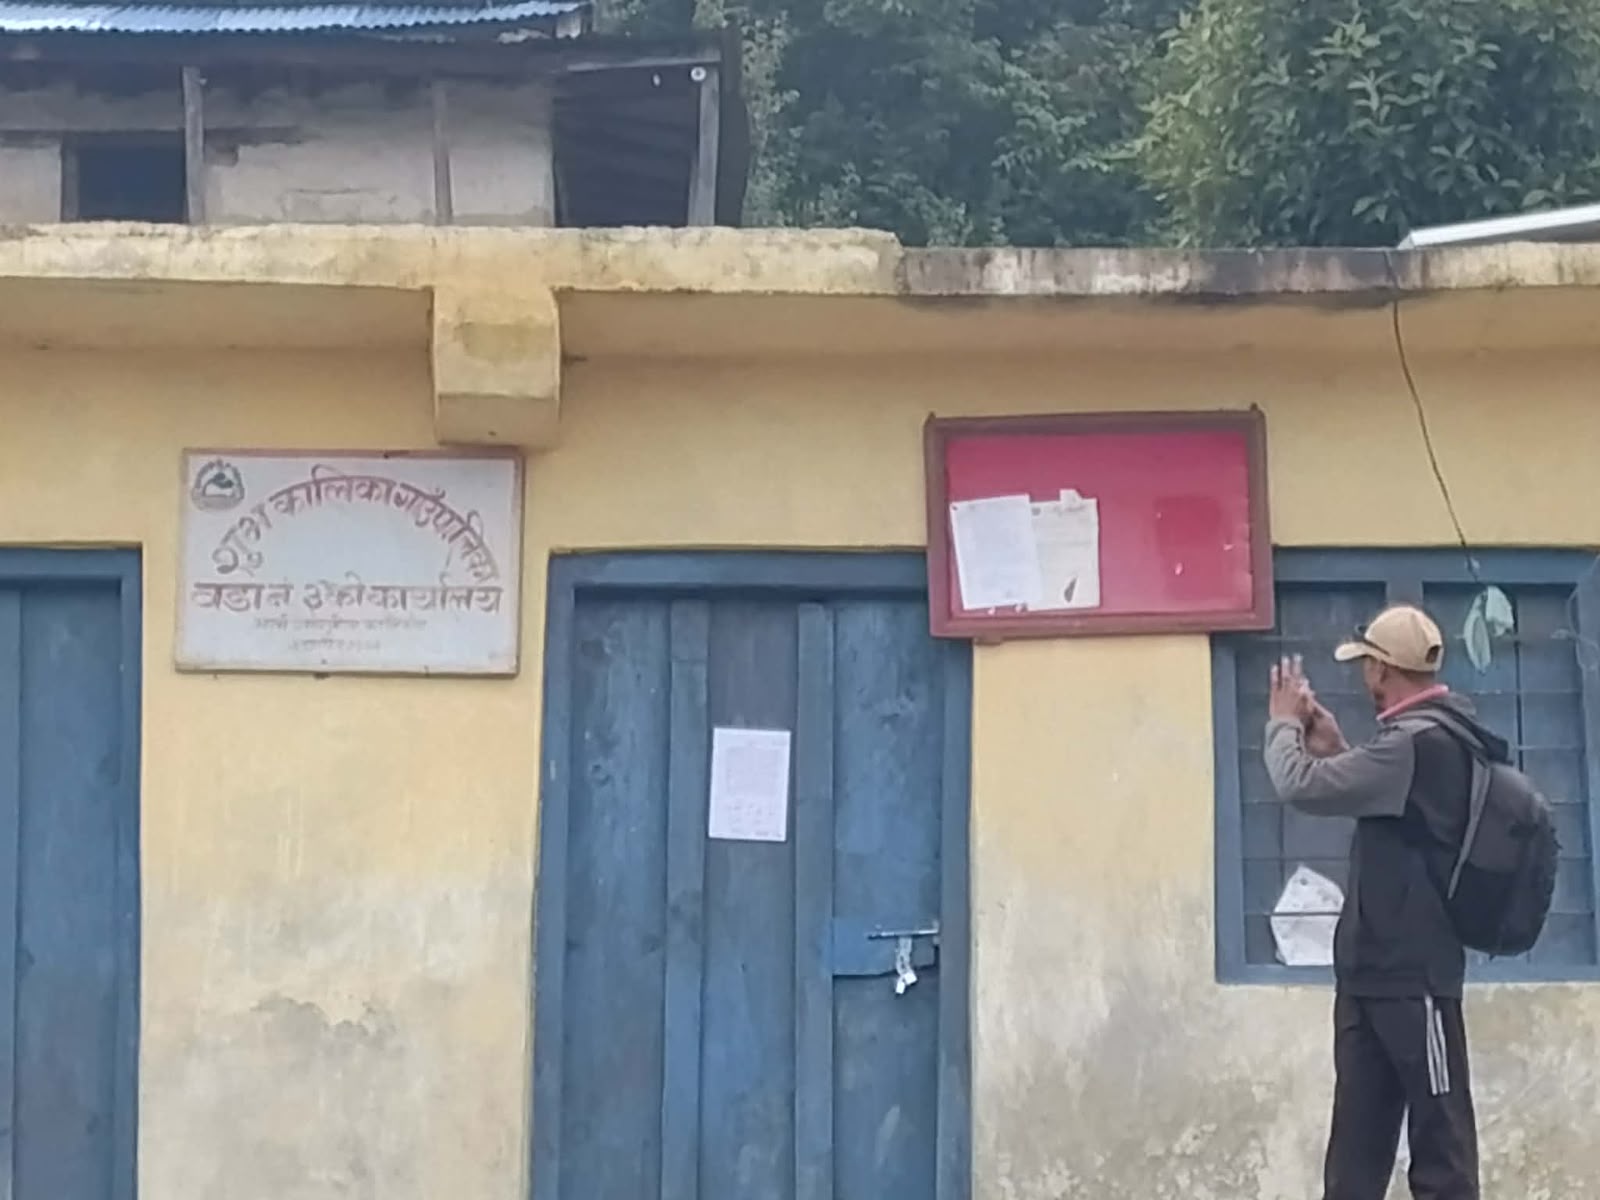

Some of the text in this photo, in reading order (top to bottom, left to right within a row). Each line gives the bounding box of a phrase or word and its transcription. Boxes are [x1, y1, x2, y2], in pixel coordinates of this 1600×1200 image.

[268, 464, 398, 516] कालिका
[192, 582, 265, 612] वडा
[366, 568, 503, 613] कार्यालय
